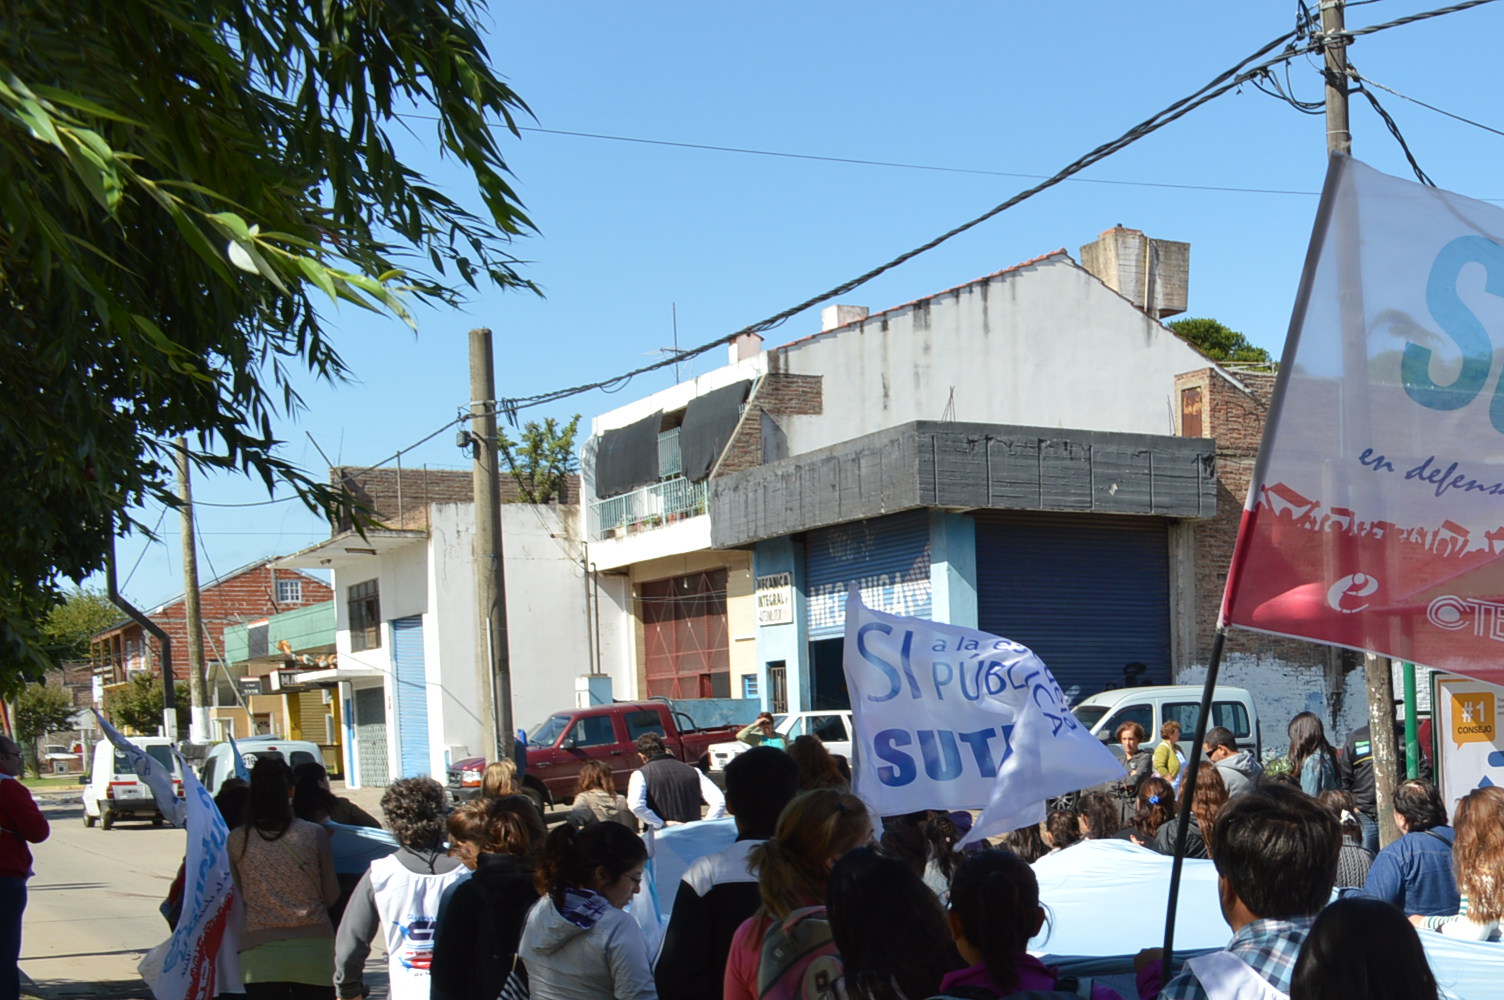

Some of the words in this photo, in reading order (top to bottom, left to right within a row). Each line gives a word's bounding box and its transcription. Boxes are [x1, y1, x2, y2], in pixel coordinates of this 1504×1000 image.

[1358, 448, 1394, 473] en
[810, 572, 906, 628] MECNICA
[857, 622, 922, 702] SI
[931, 638, 947, 652] a
[956, 636, 979, 651] la
[1461, 701, 1485, 723] #1
[1457, 725, 1492, 734] CONSEJO
